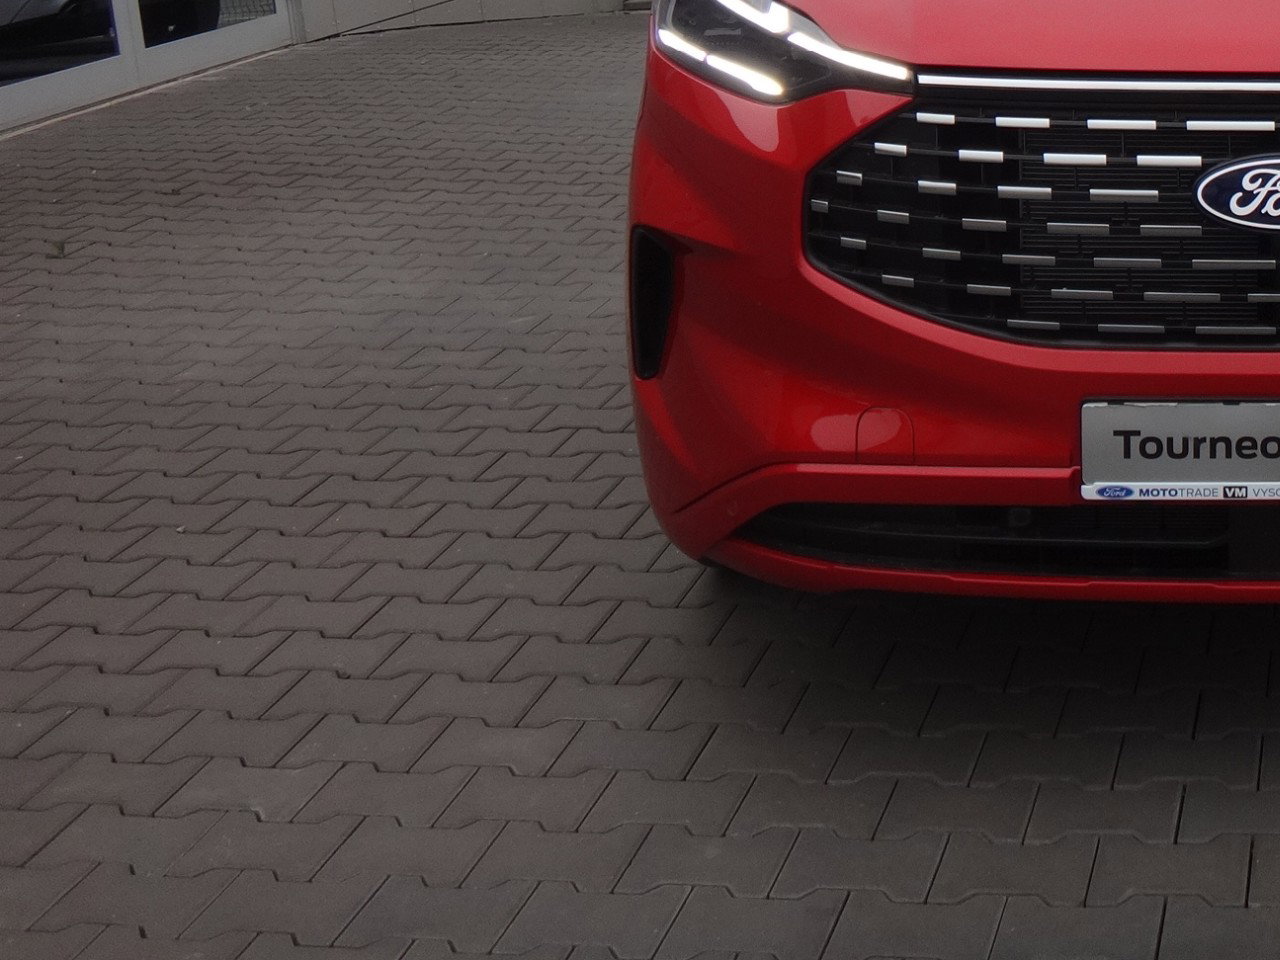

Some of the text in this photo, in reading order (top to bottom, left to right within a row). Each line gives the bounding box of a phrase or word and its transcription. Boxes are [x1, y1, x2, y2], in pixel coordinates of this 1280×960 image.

[1103, 487, 1128, 498] Ford
[1138, 488, 1219, 497] MOTOTRADE
[1225, 487, 1246, 497] VM
